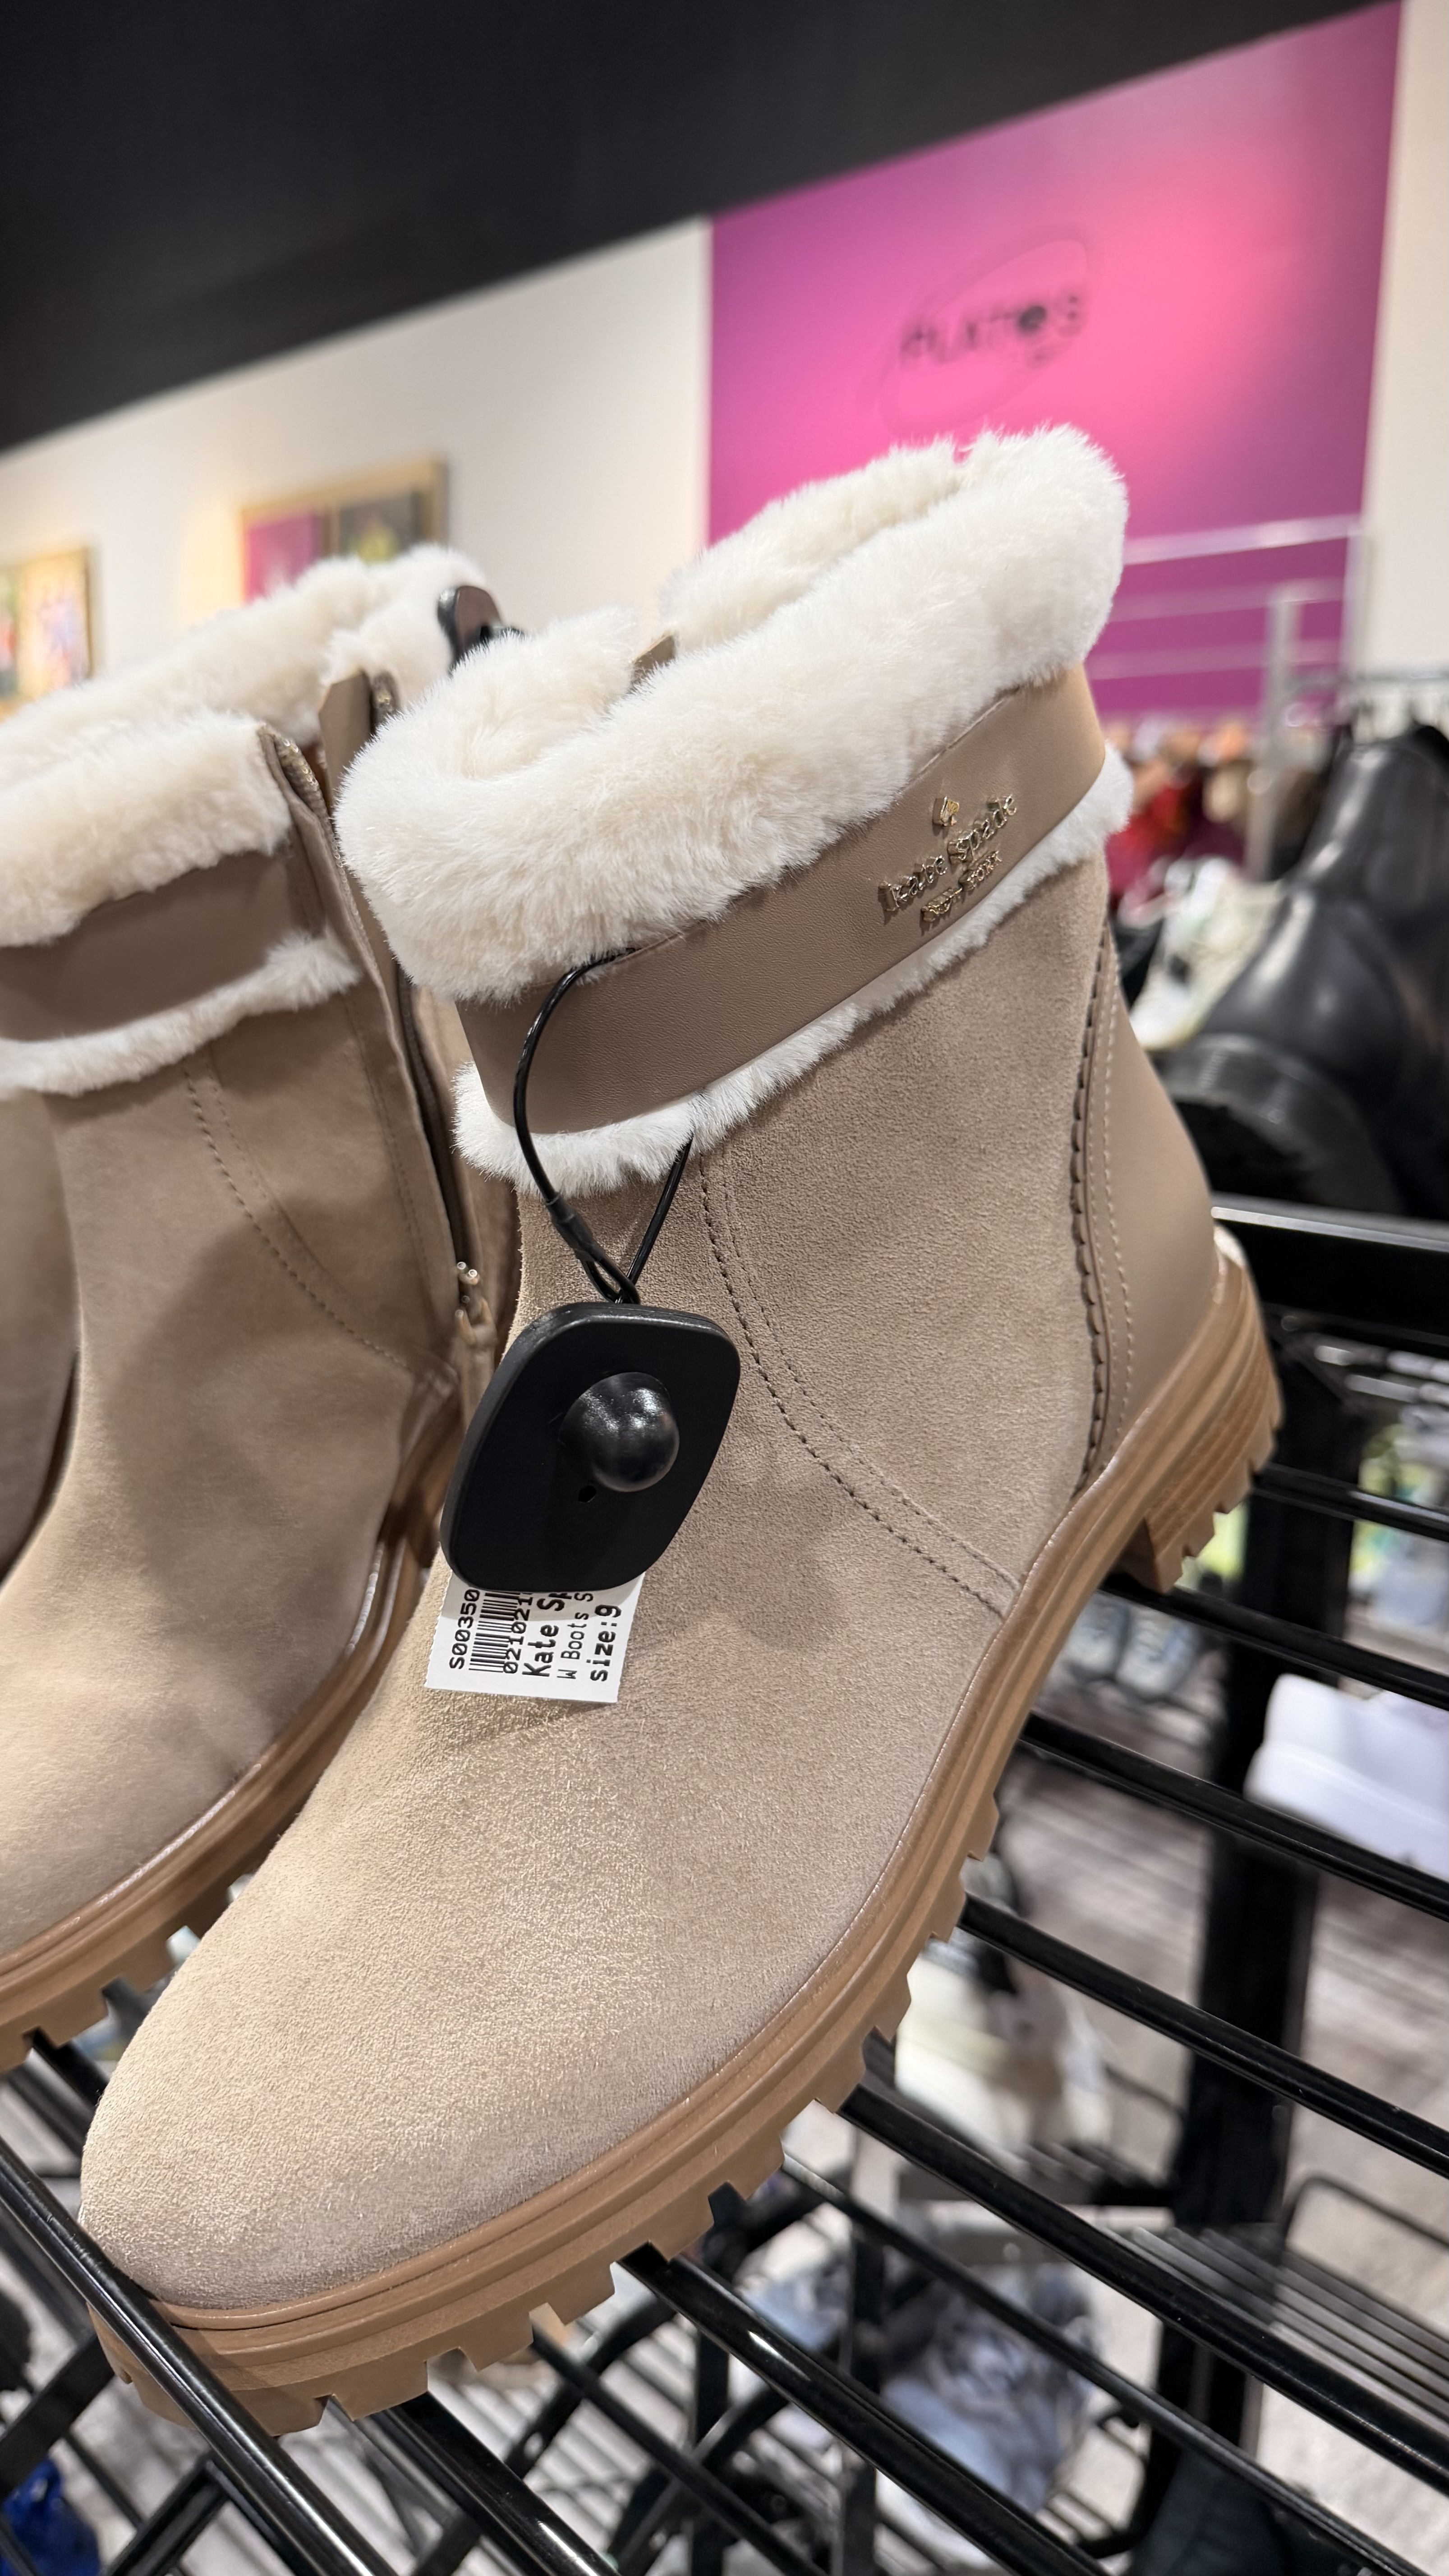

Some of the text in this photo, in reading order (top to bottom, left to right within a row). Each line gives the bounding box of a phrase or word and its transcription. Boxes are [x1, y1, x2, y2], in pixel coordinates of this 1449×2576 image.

[449, 1589, 480, 1670] S00350
[503, 1592, 534, 1674] 021021
[522, 1624, 559, 1677] Kate
[561, 1612, 589, 1660] Boots
[586, 1604, 621, 1682] size:9
[557, 1669, 577, 1679] W
